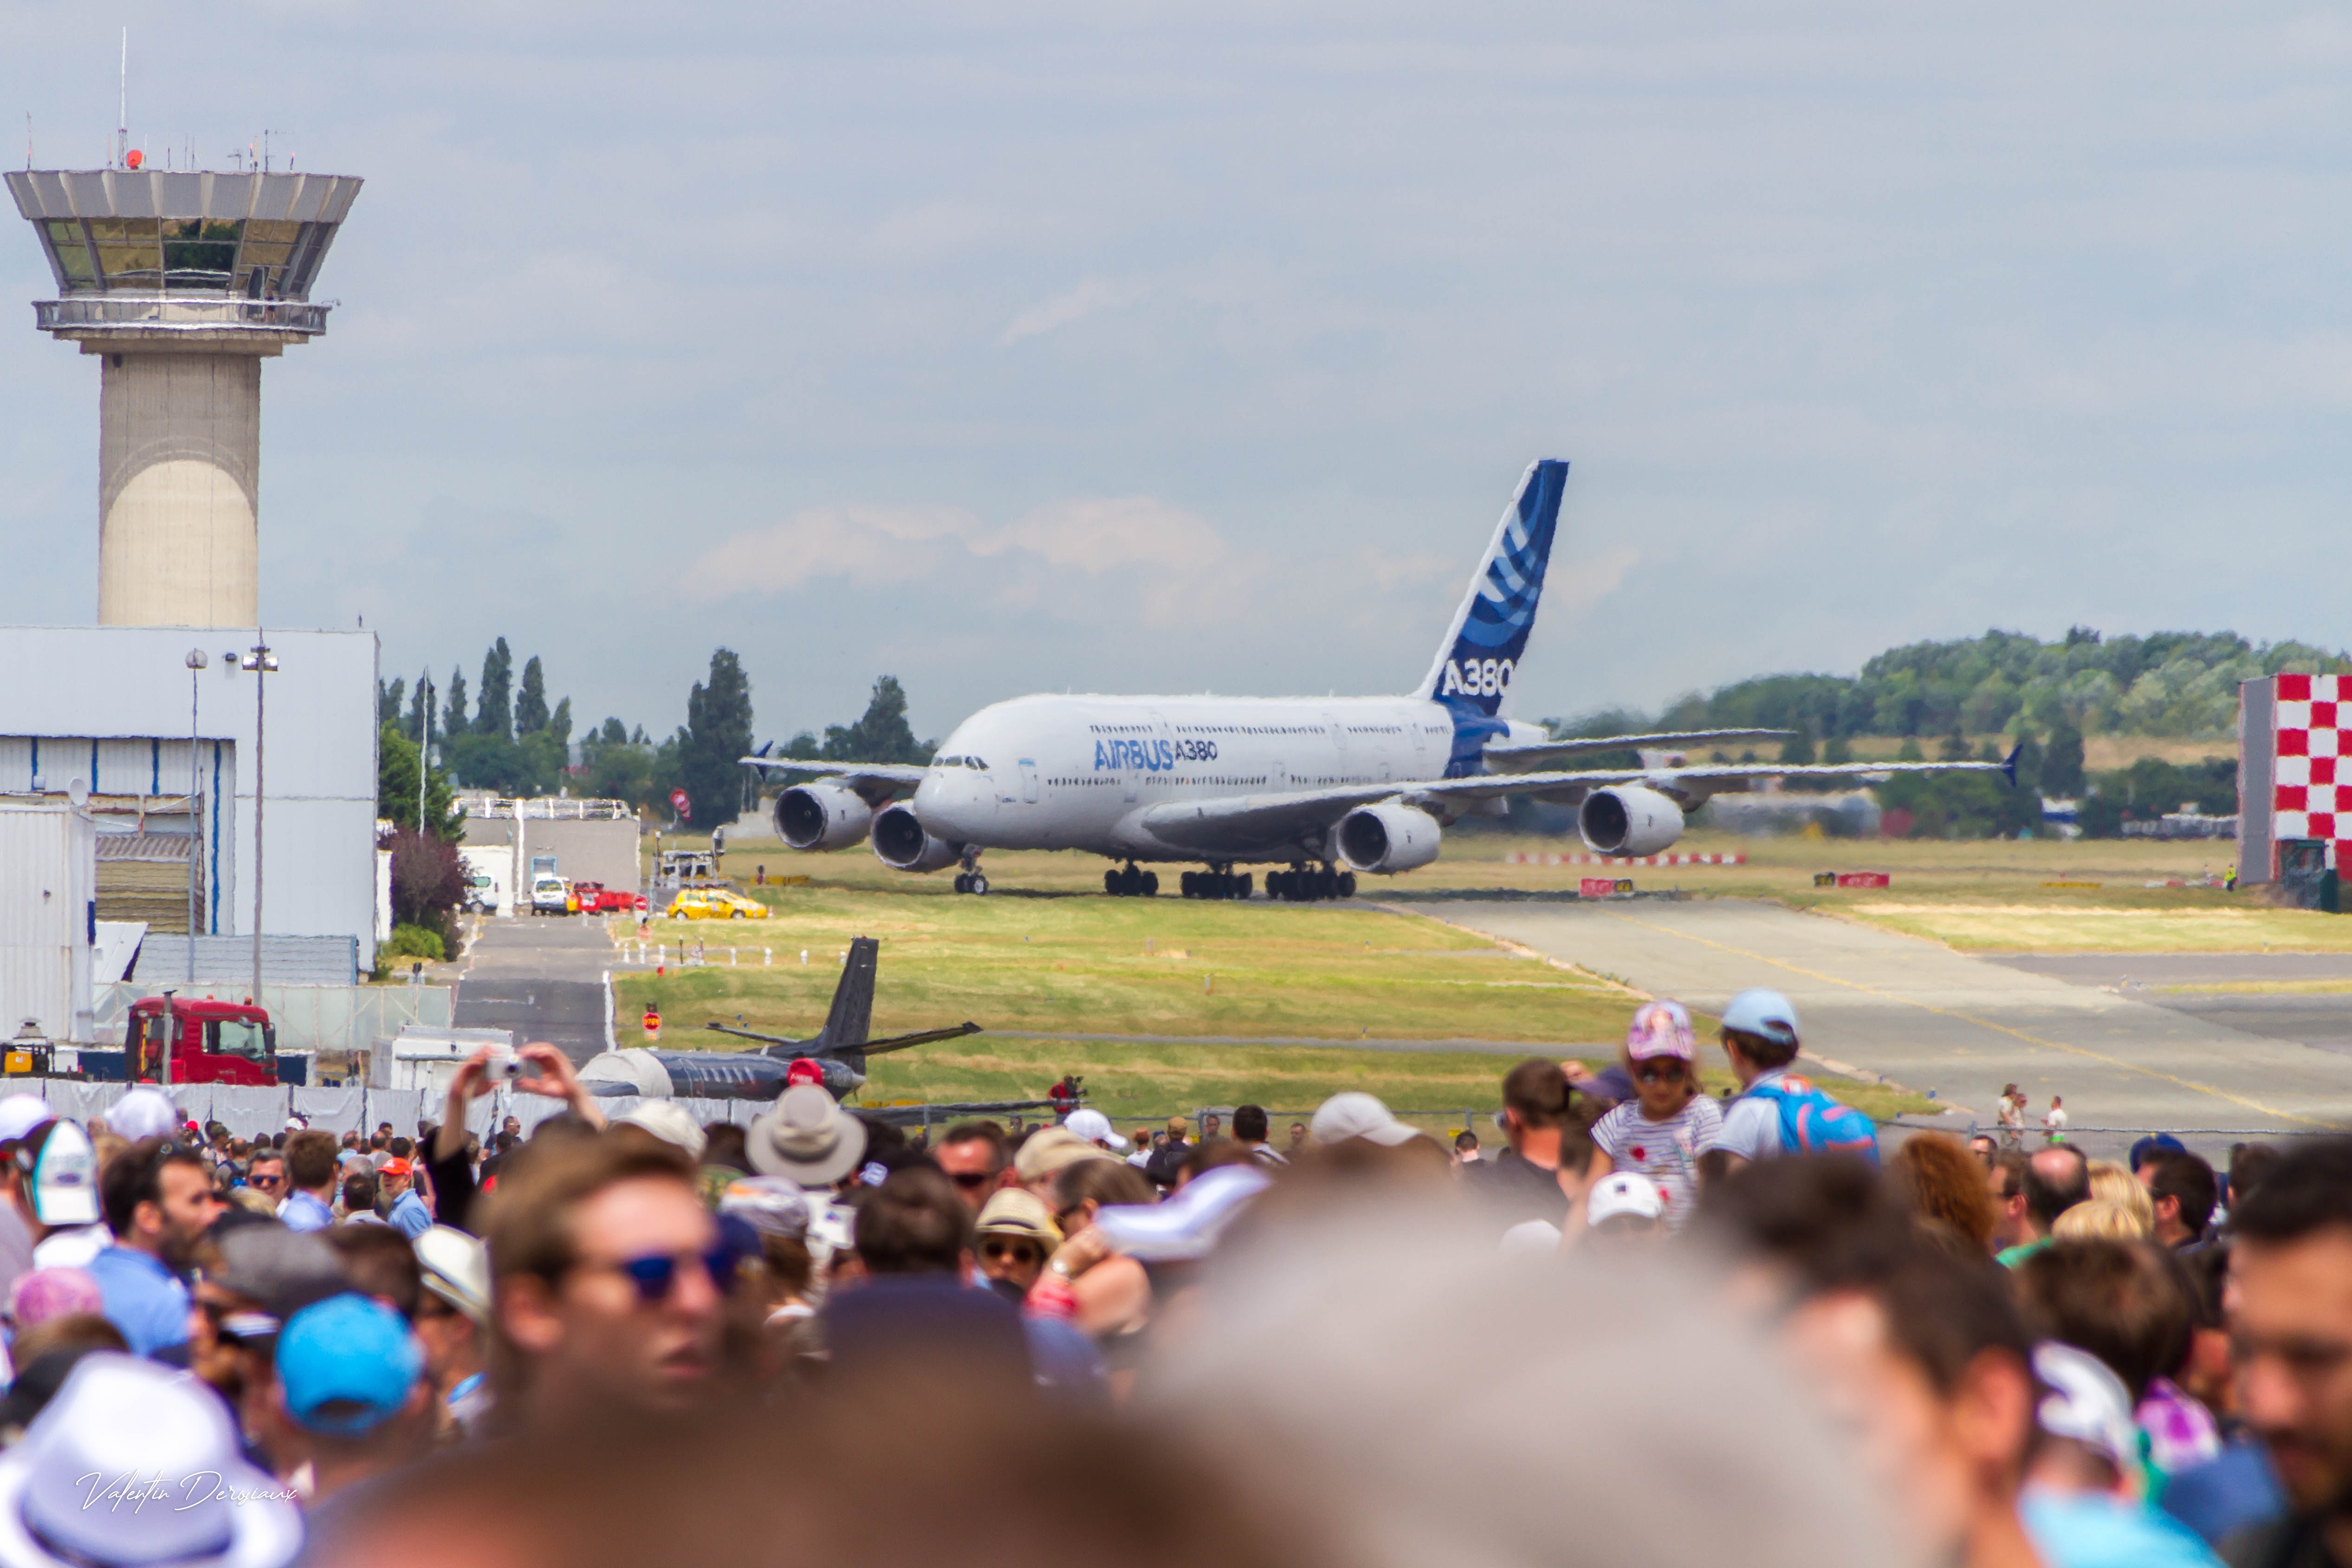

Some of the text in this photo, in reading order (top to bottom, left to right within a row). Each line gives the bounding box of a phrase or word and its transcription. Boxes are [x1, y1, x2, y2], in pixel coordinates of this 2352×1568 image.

[1441, 658, 1513, 697] A380
[1094, 739, 1218, 771] AIRBUS A380
